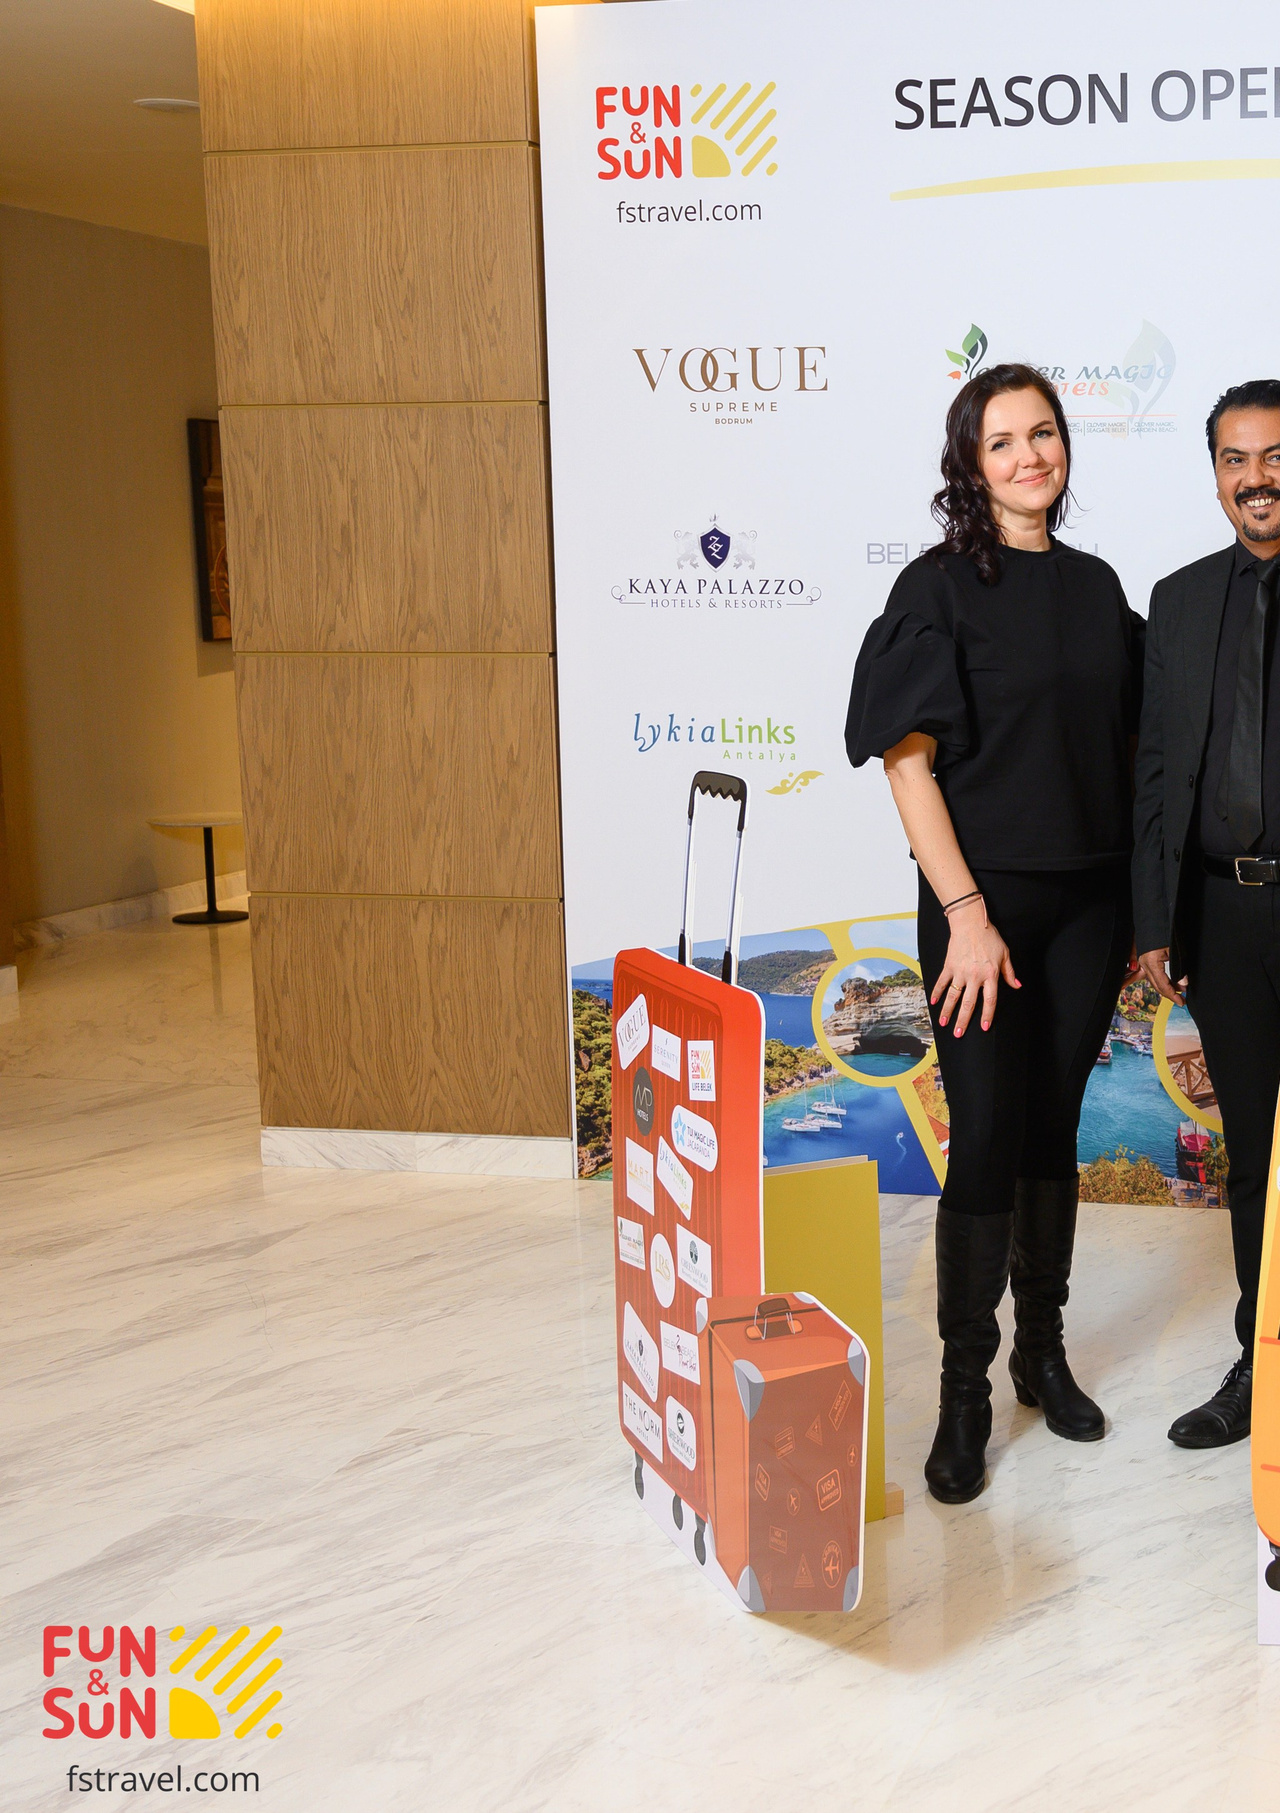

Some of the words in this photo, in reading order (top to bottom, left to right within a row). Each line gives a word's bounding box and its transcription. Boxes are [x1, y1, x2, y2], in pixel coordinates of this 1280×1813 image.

[596, 84, 681, 130] FUN
[894, 72, 1128, 130] SEASON
[630, 121, 647, 144] &
[597, 135, 682, 180] SUN
[616, 199, 762, 223] fstravel.com
[632, 346, 828, 393] VOGUE
[1076, 364, 1173, 383] MAGIC
[1054, 382, 1109, 396] TELS
[689, 401, 778, 412] SUPREME
[628, 578, 688, 594] KAYA
[697, 579, 804, 595] PALAZZO
[651, 599, 701, 608] HOTELS
[708, 598, 718, 609] &
[725, 599, 782, 609] RESORTS
[723, 749, 796, 763] Antalya
[821, 1477, 836, 1494] VISA
